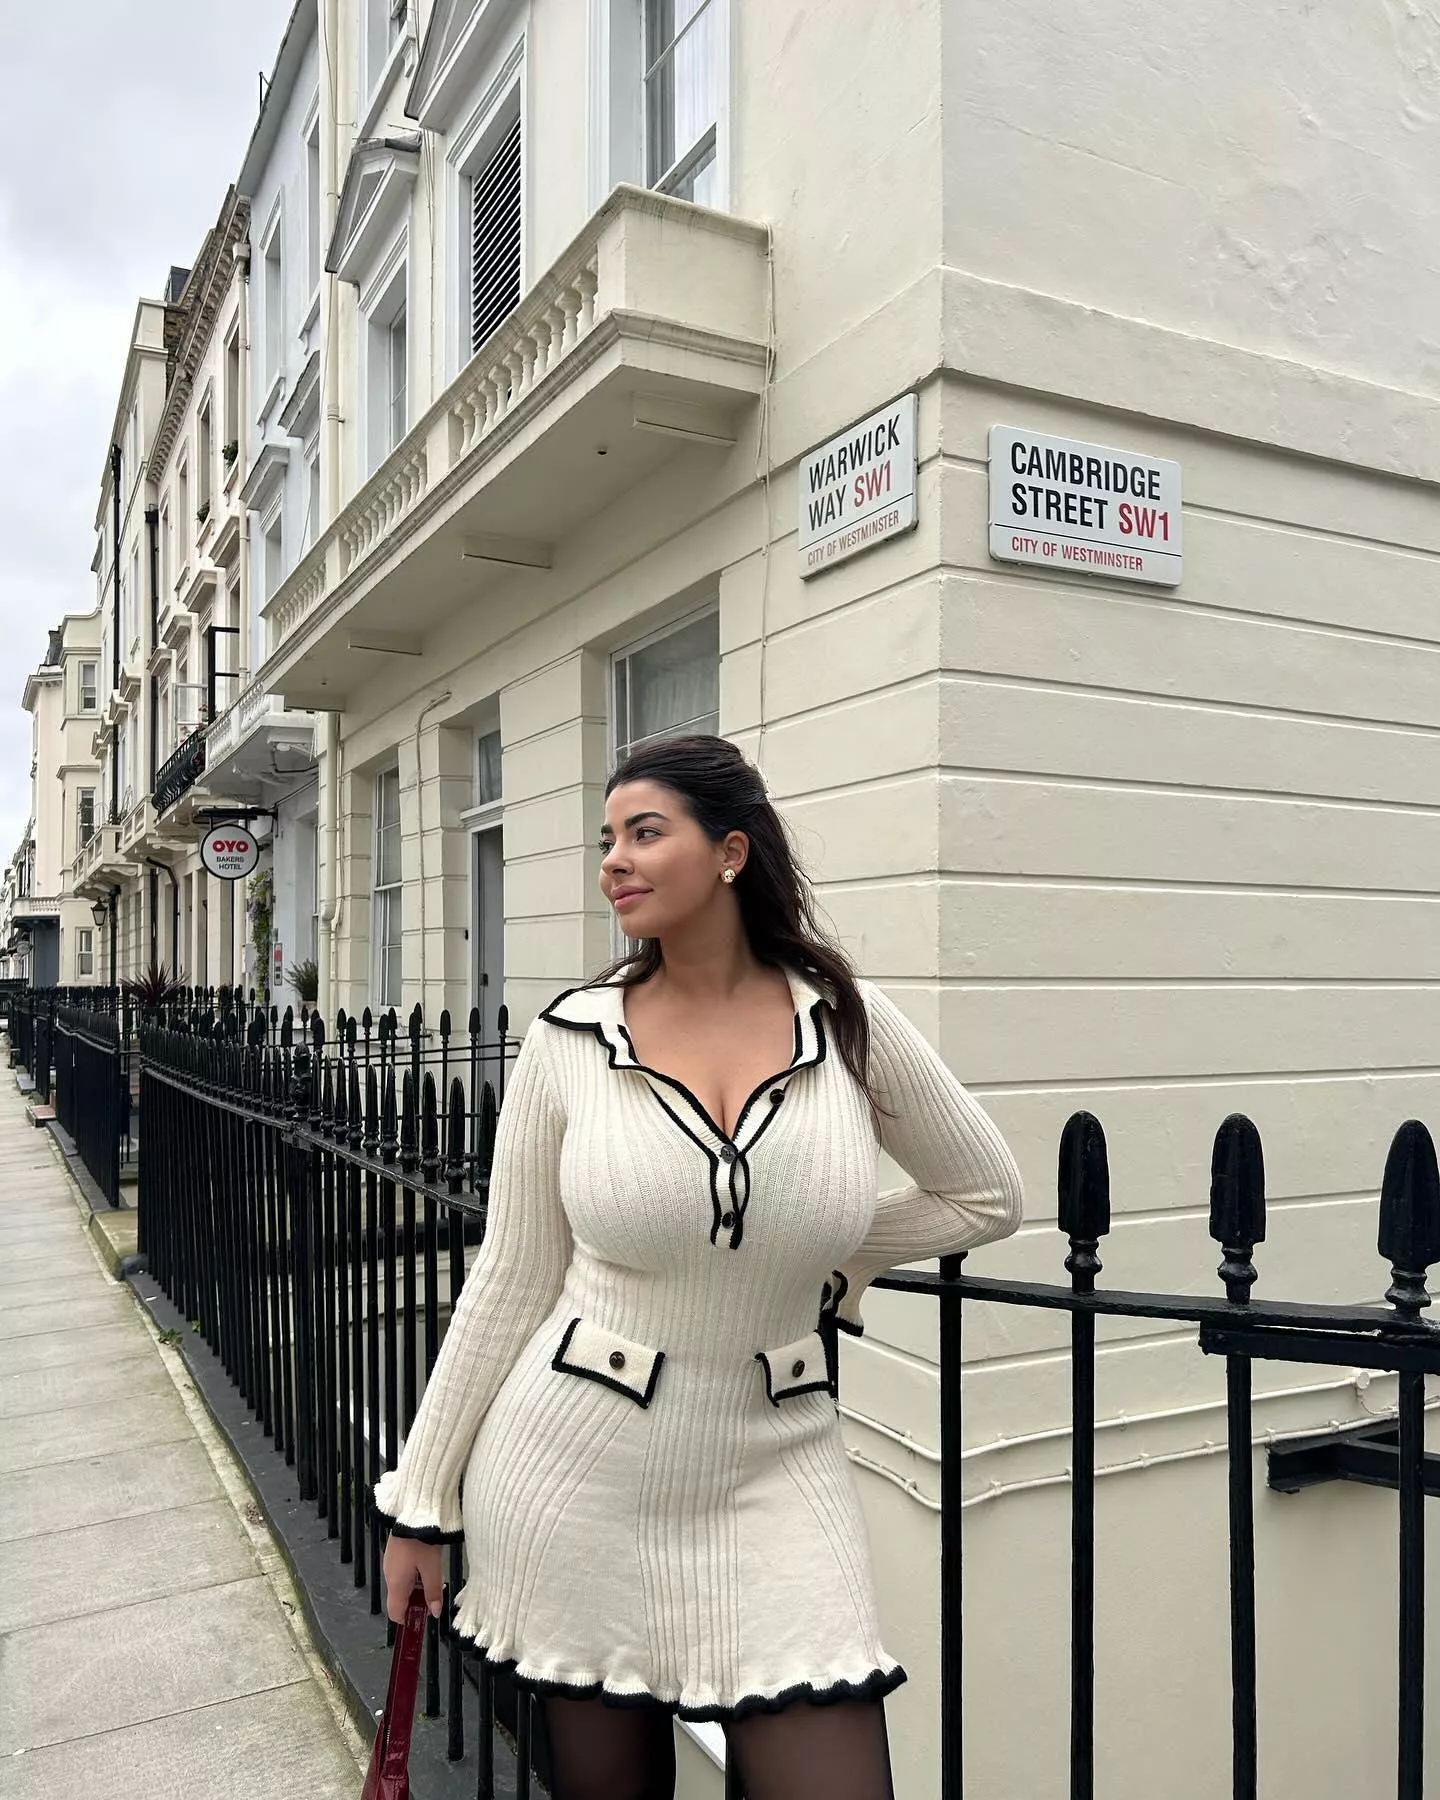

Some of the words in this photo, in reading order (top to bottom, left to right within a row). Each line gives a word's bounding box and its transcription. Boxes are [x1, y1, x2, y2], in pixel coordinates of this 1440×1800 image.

[809, 414, 900, 494] WARWICK
[1011, 441, 1161, 501] CAMBRIDGE
[808, 484, 847, 531] WAY
[854, 459, 892, 508] SW1
[1011, 482, 1108, 530] STREET
[1118, 502, 1169, 541] SW1
[807, 546, 825, 566] CITY
[827, 538, 837, 558] OF
[838, 509, 900, 551] WESTMINSTER
[1012, 536, 1038, 554] CITY
[1042, 541, 1057, 557] OF
[1061, 544, 1143, 571] WESTMINSTER
[212, 840, 249, 853] OYO
